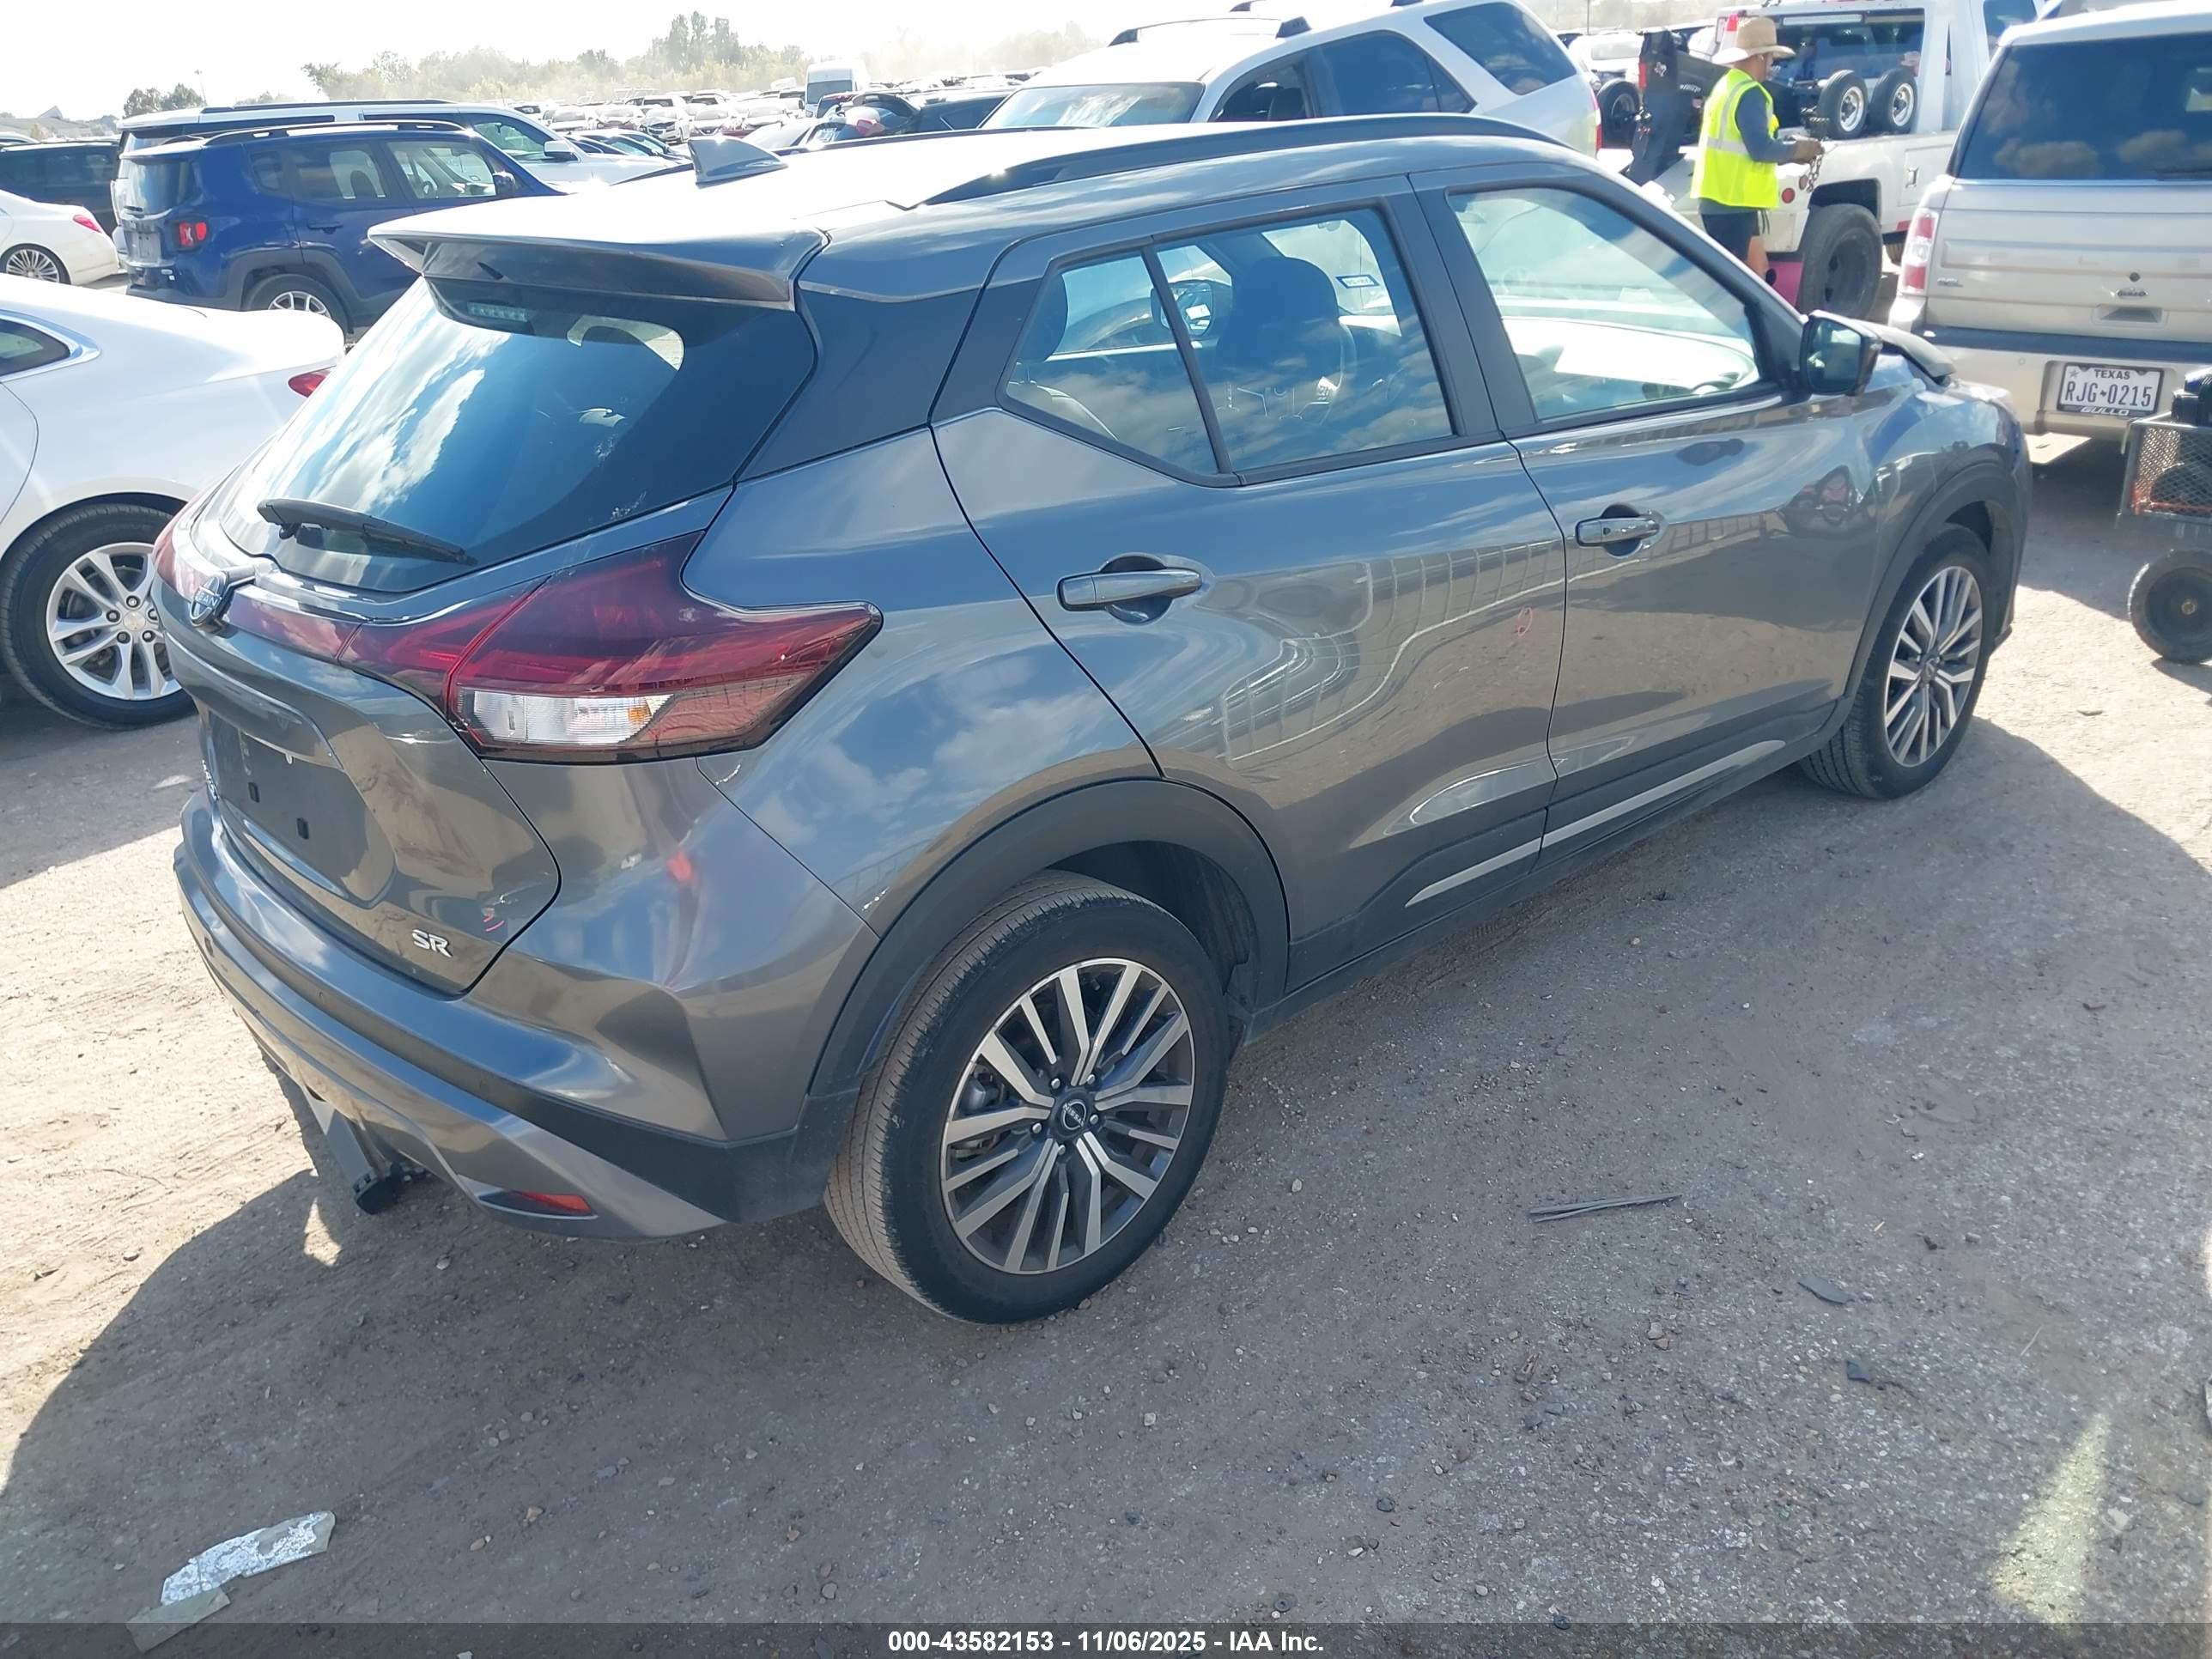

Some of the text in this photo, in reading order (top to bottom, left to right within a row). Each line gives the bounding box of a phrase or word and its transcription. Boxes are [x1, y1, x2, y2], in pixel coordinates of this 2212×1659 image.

[2094, 369, 2130, 380] TEXAS
[2080, 406, 2130, 416] GULLO
[412, 928, 453, 957] SR
